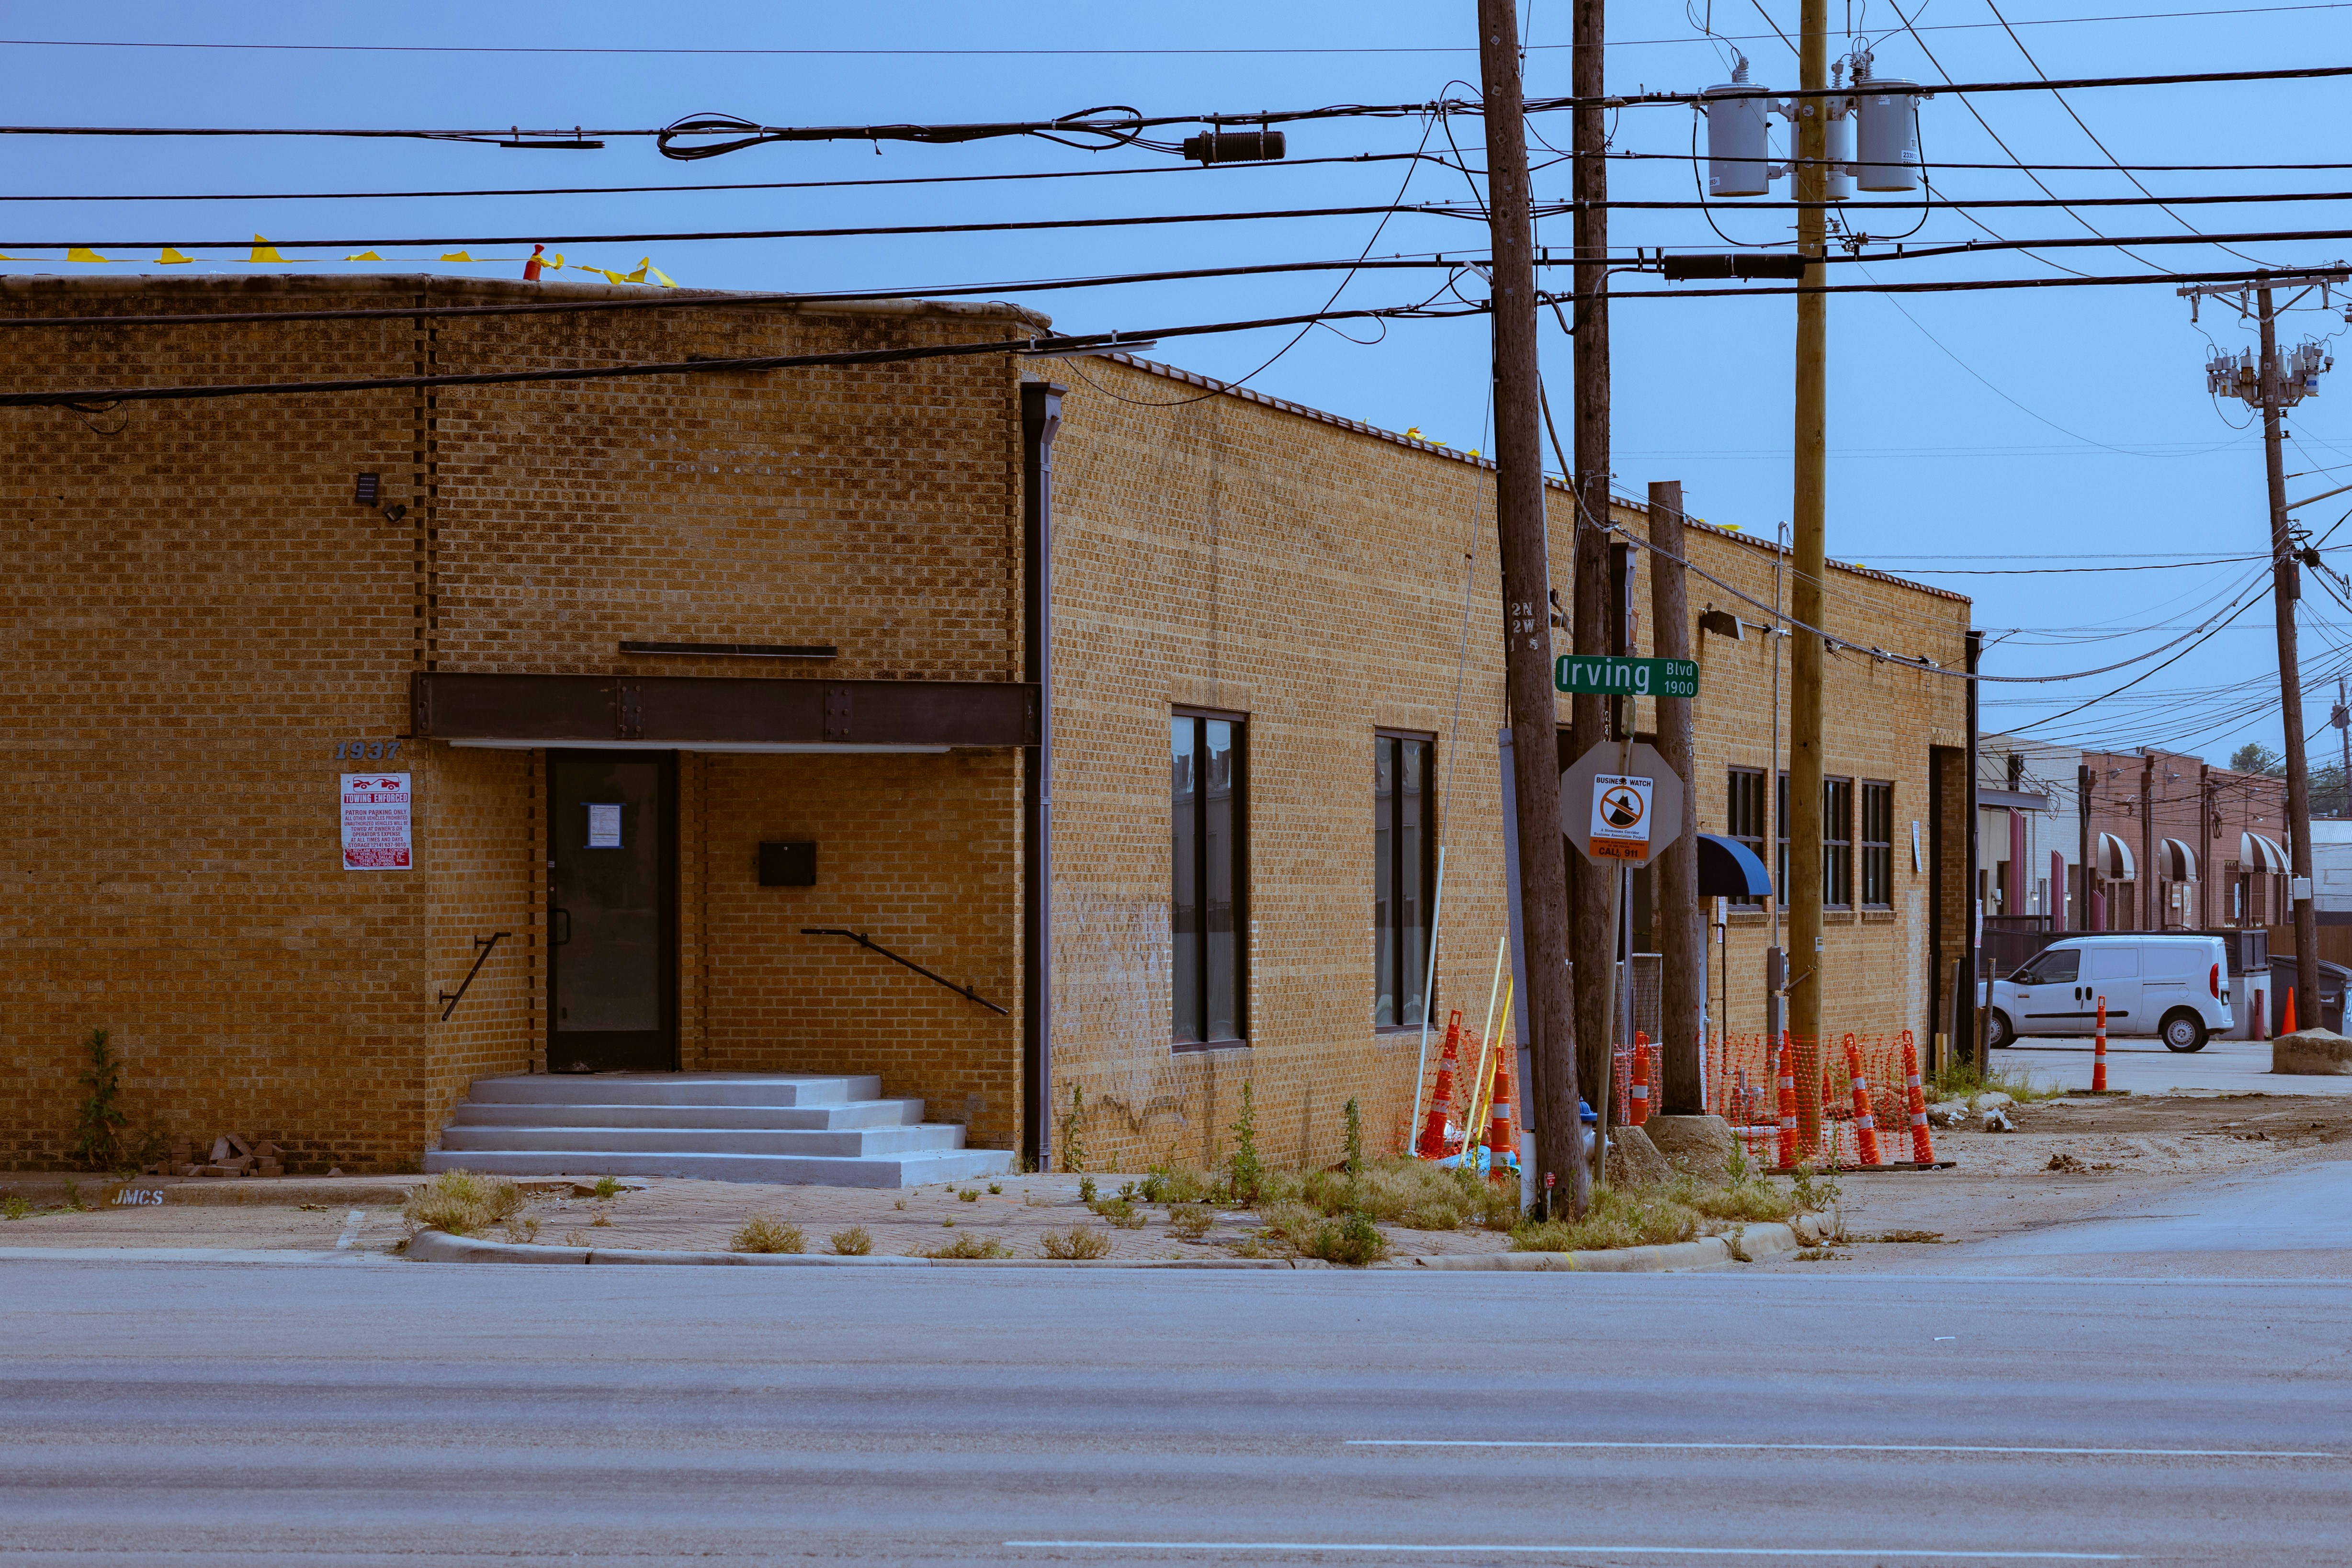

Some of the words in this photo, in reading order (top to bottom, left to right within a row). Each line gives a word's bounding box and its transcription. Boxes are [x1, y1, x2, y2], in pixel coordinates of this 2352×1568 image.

[1563, 658, 1650, 695] Irving
[1667, 662, 1692, 676] Blvd
[1664, 681, 1693, 694] 1900
[335, 742, 401, 759] 1937
[345, 794, 372, 802] TOWING
[374, 793, 407, 802] ENFORCED
[1599, 847, 1620, 857] CALL
[1625, 849, 1638, 857] 911
[112, 1189, 164, 1205] JMCS
